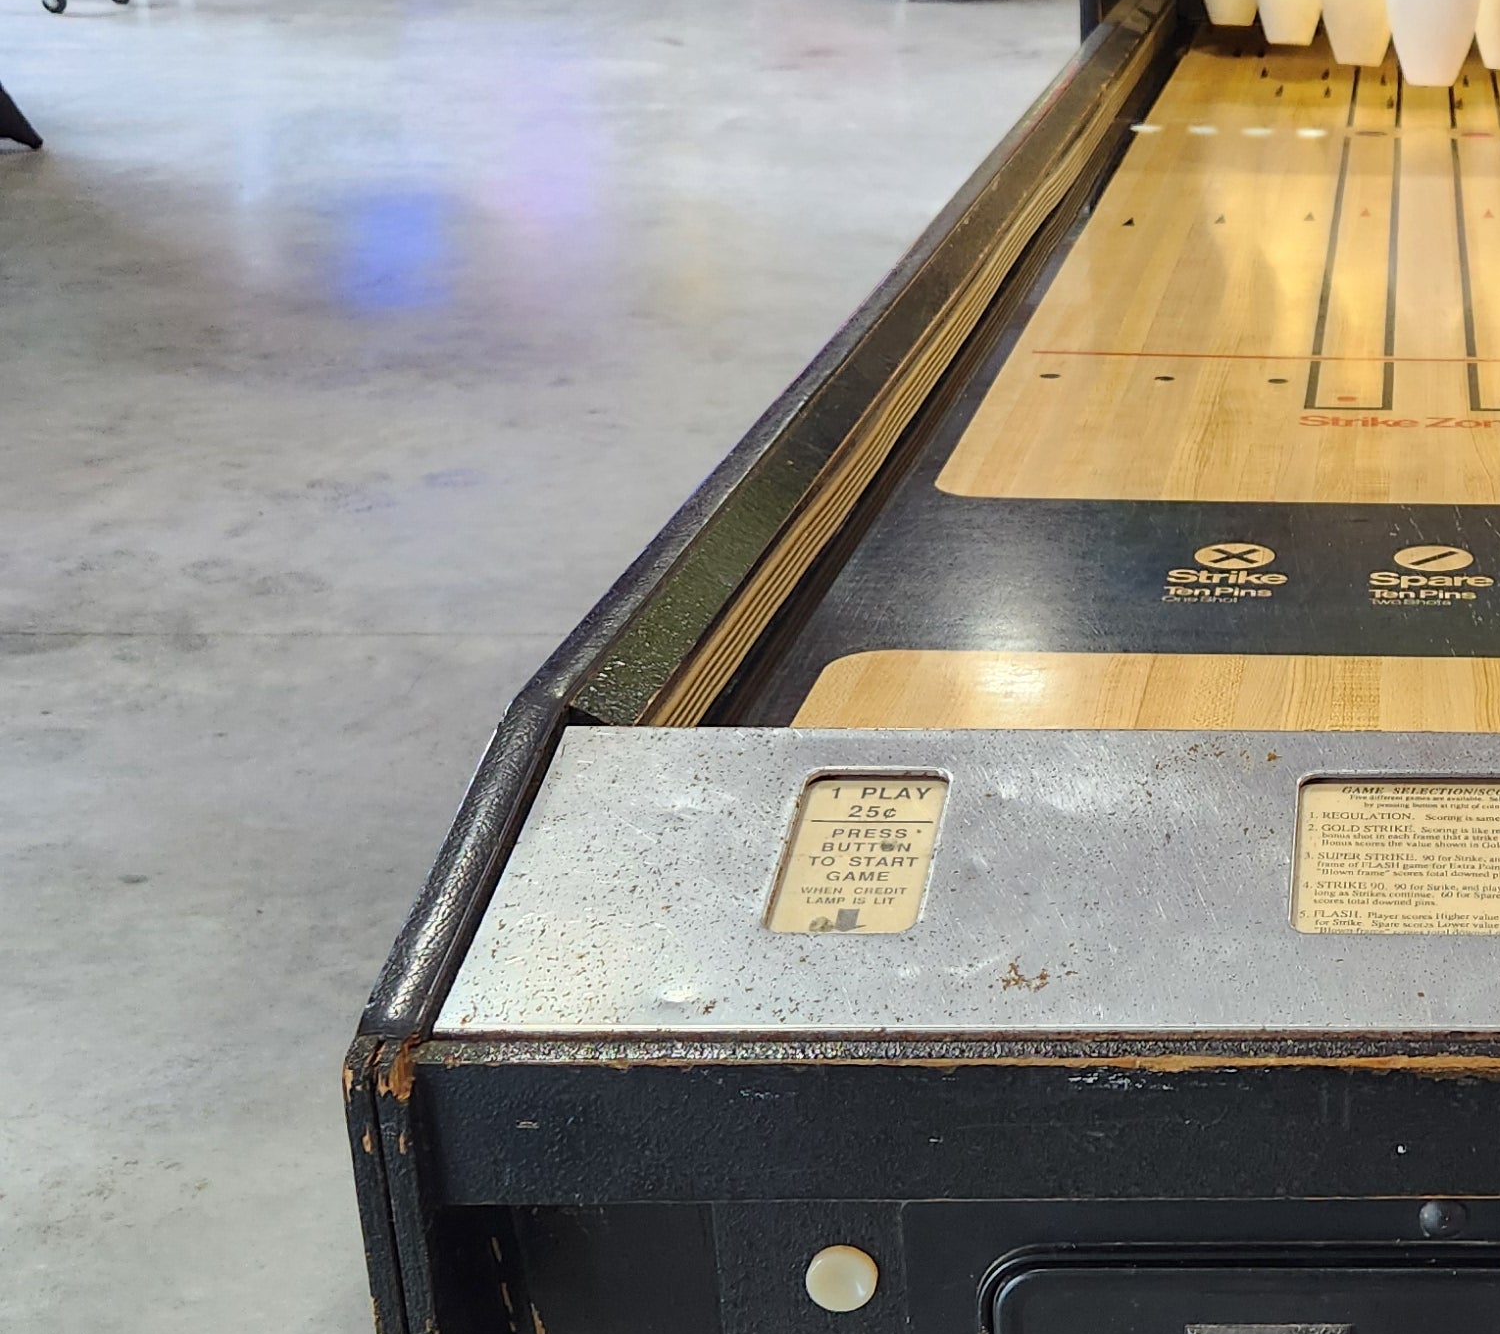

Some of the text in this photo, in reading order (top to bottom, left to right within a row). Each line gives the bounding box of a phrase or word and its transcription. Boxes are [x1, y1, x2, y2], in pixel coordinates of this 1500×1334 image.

[1298, 415, 1419, 428] Strike
[1166, 569, 1289, 585] Strike
[1368, 571, 1495, 589] Spare
[1163, 585, 1273, 597] Ten Pins
[1368, 589, 1477, 600] Ten Pins
[832, 787, 932, 799] 1 PLAY
[848, 805, 897, 818] 25¢
[1425, 814, 1462, 822] Scoring
[1321, 824, 1360, 832] GOLD
[831, 829, 908, 839] PRESS
[821, 842, 911, 852] BUTTON
[1317, 852, 1360, 860] SUPER
[809, 856, 918, 867] TO START
[826, 871, 890, 881] GAME
[801, 886, 907, 895] WHEN CREDIT
[806, 897, 896, 905] LAMP IS LIT
[1368, 912, 1399, 920] Player
